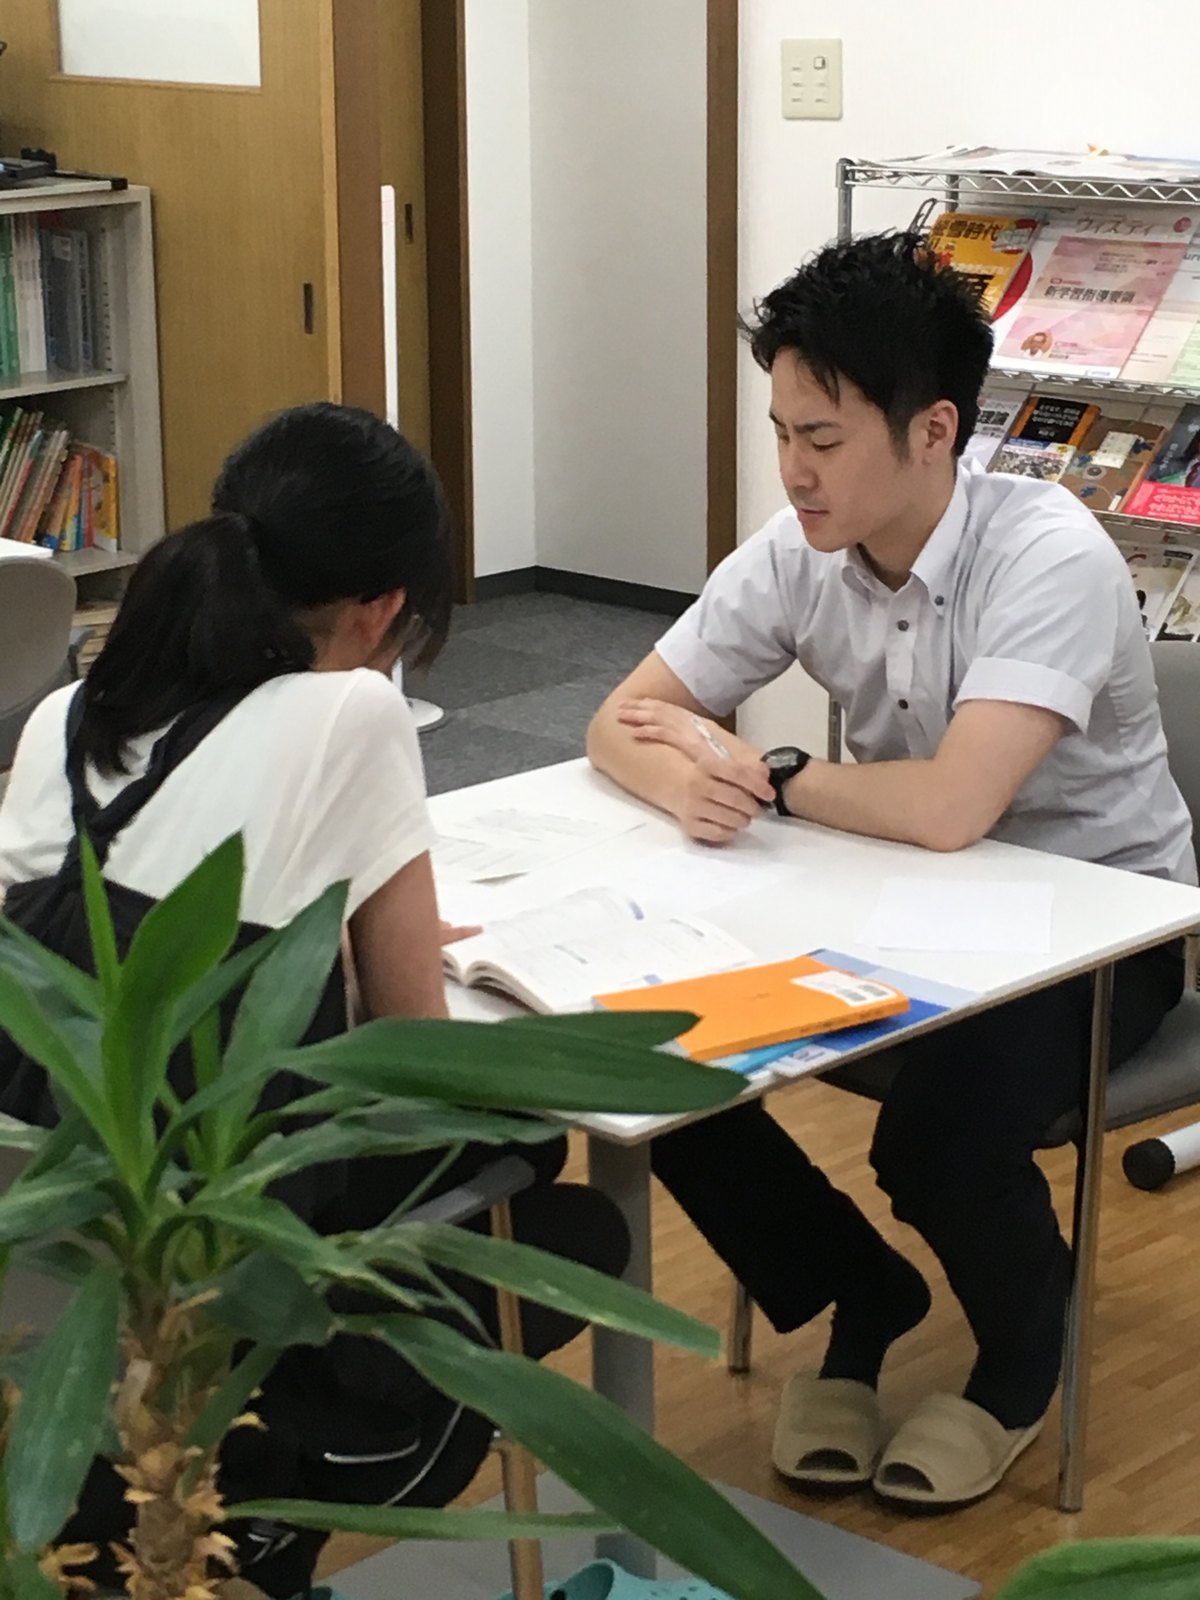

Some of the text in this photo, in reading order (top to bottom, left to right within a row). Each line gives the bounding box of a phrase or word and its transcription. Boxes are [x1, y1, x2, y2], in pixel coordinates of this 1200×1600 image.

[1044, 285, 1137, 304] 新学習指導要領
